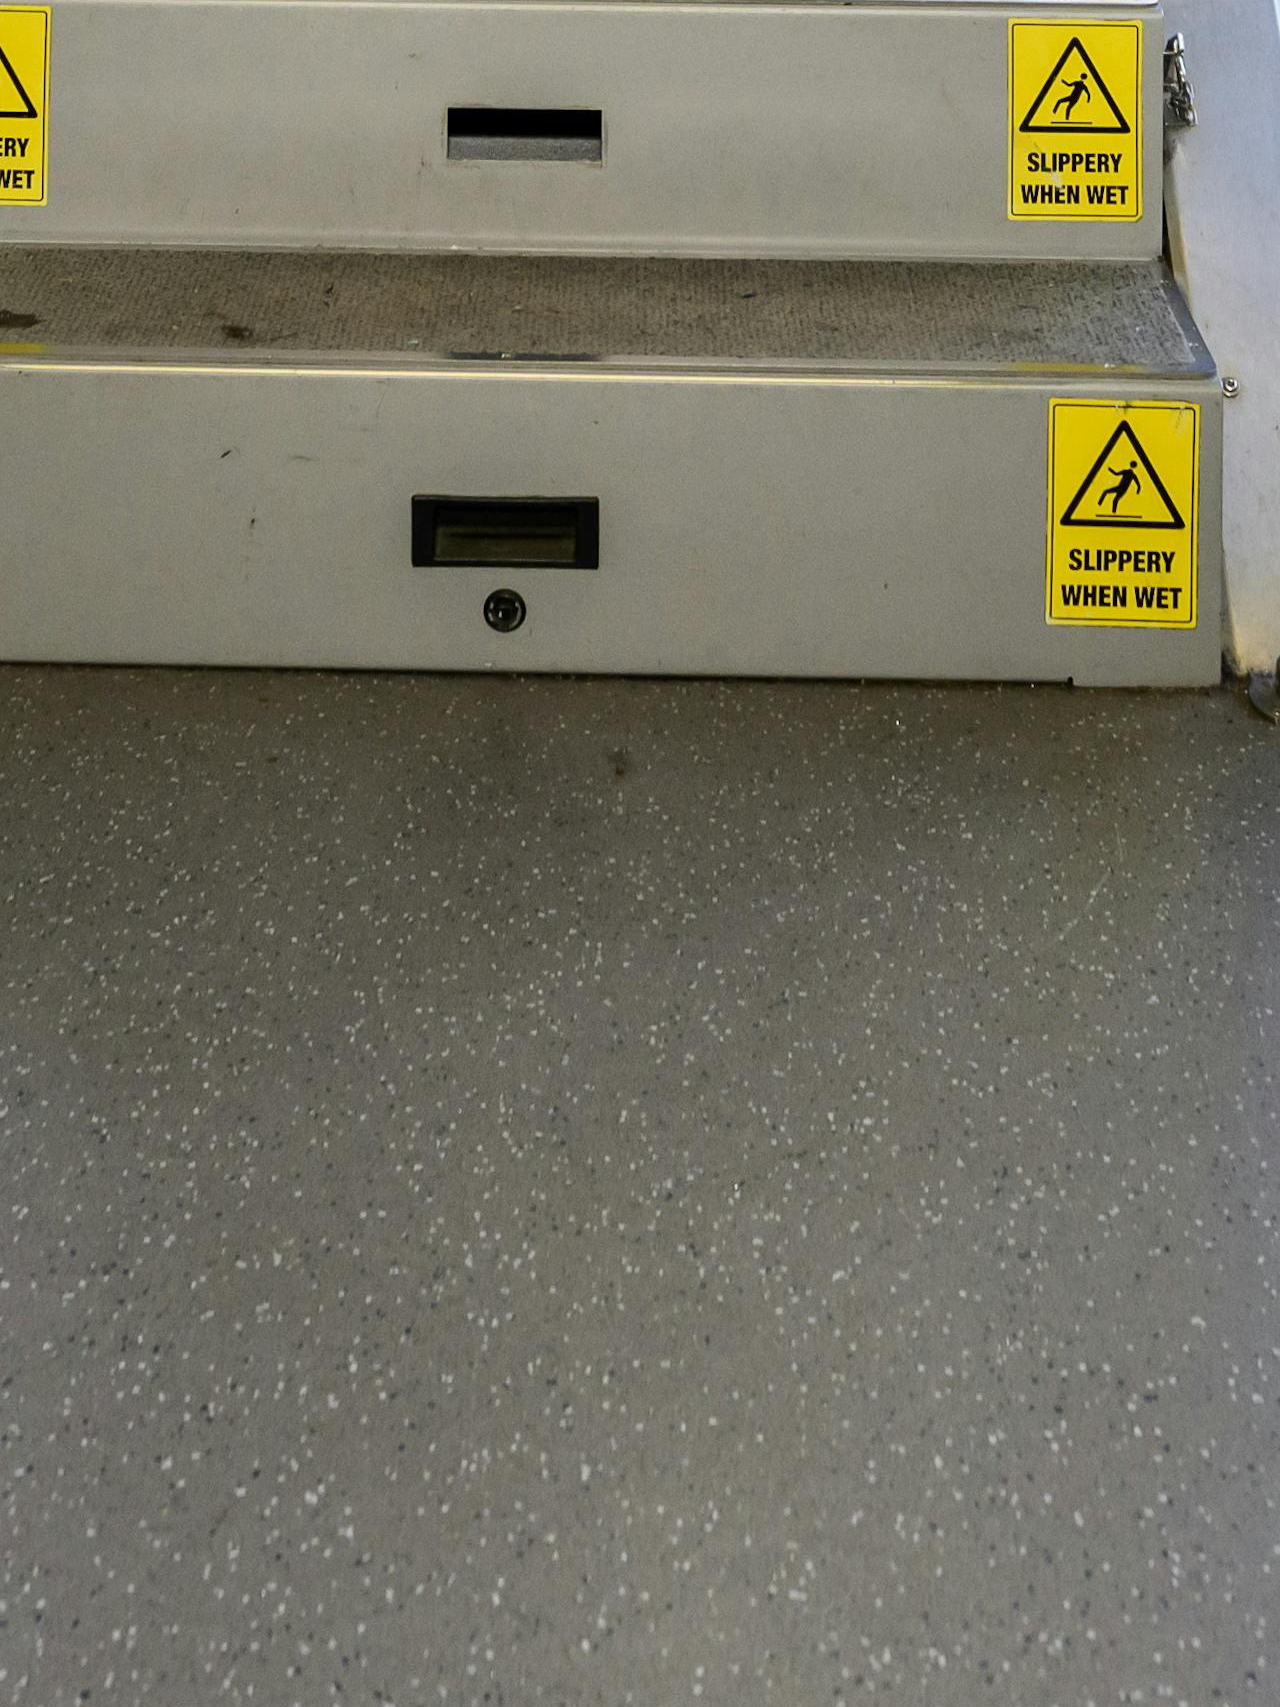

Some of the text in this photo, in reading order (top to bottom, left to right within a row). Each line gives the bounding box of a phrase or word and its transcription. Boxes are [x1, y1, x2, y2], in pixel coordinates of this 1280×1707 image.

[1028, 153, 1122, 173] SLIPPERY
[1021, 184, 1129, 204] WHEN WET
[1068, 549, 1175, 573] SLIPPERY
[1061, 584, 1182, 609] WHEN WET
